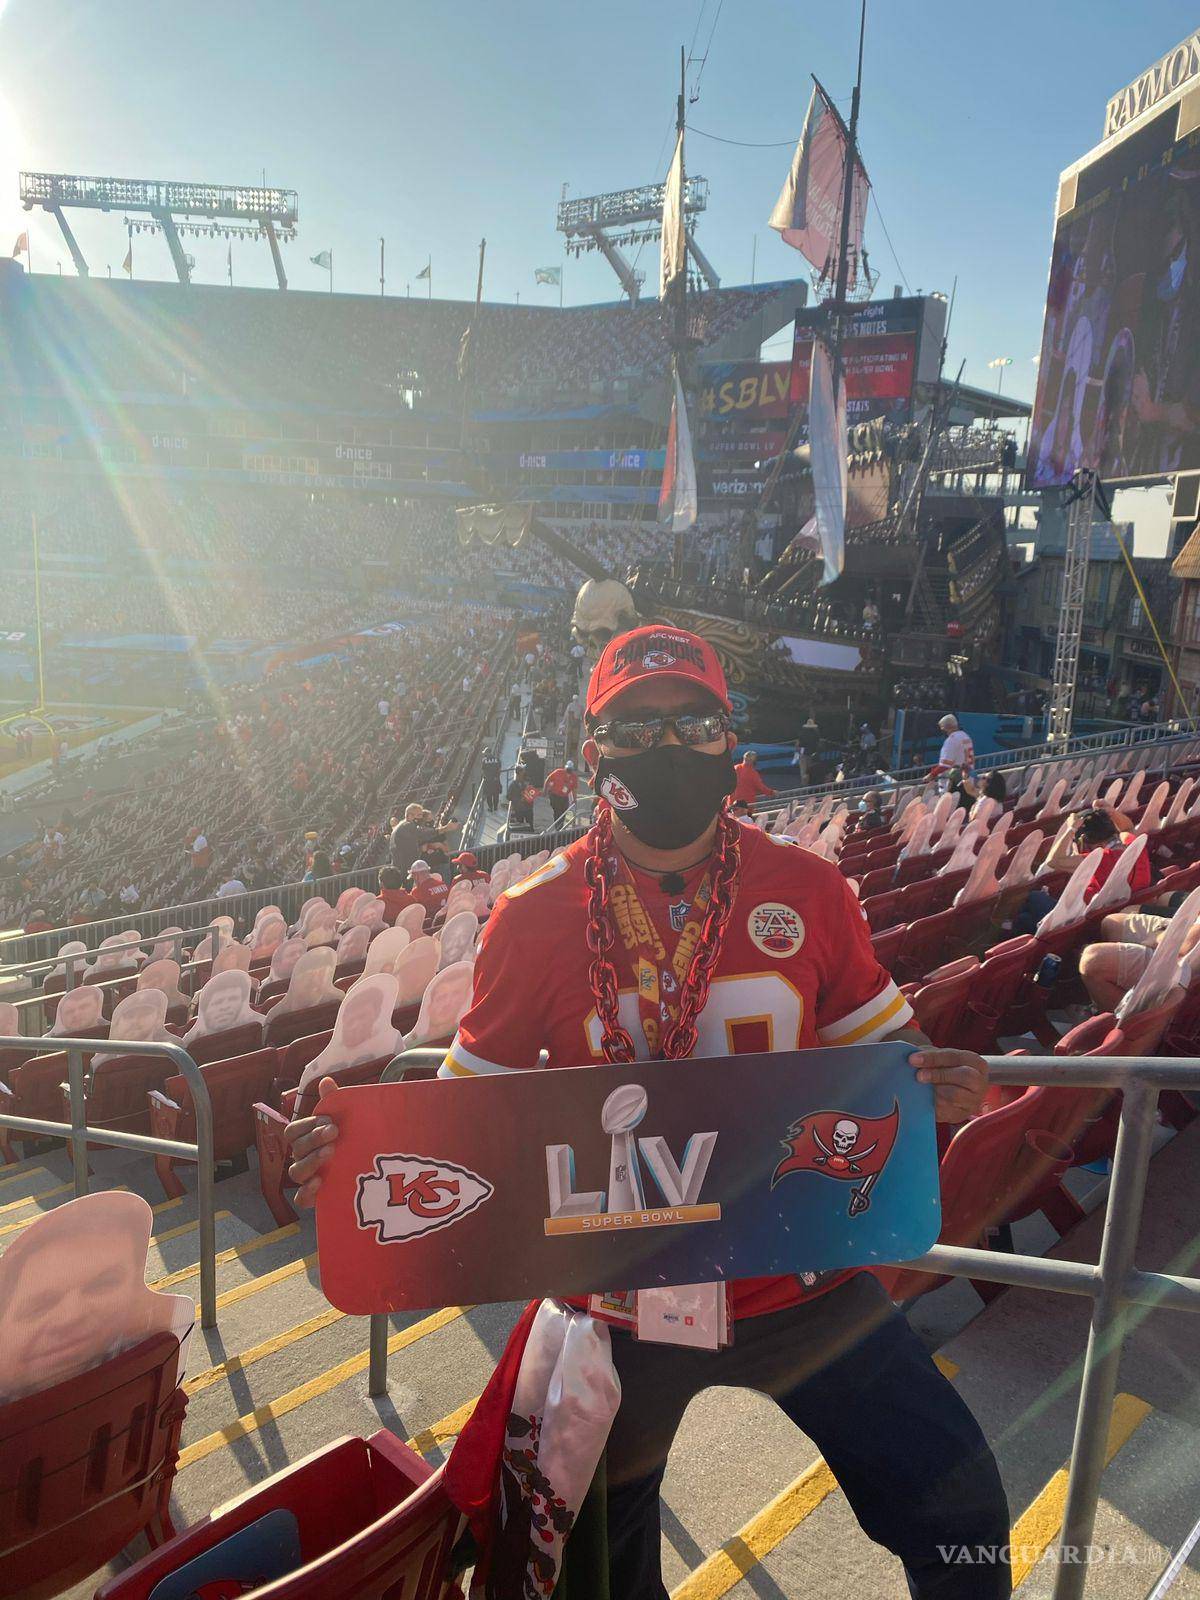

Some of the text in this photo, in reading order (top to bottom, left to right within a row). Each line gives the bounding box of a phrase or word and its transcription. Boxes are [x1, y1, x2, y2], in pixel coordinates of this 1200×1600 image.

[668, 635, 691, 644] WEST
[386, 1170, 461, 1218] KC
[582, 1210, 684, 1229] SUPER BOWL
